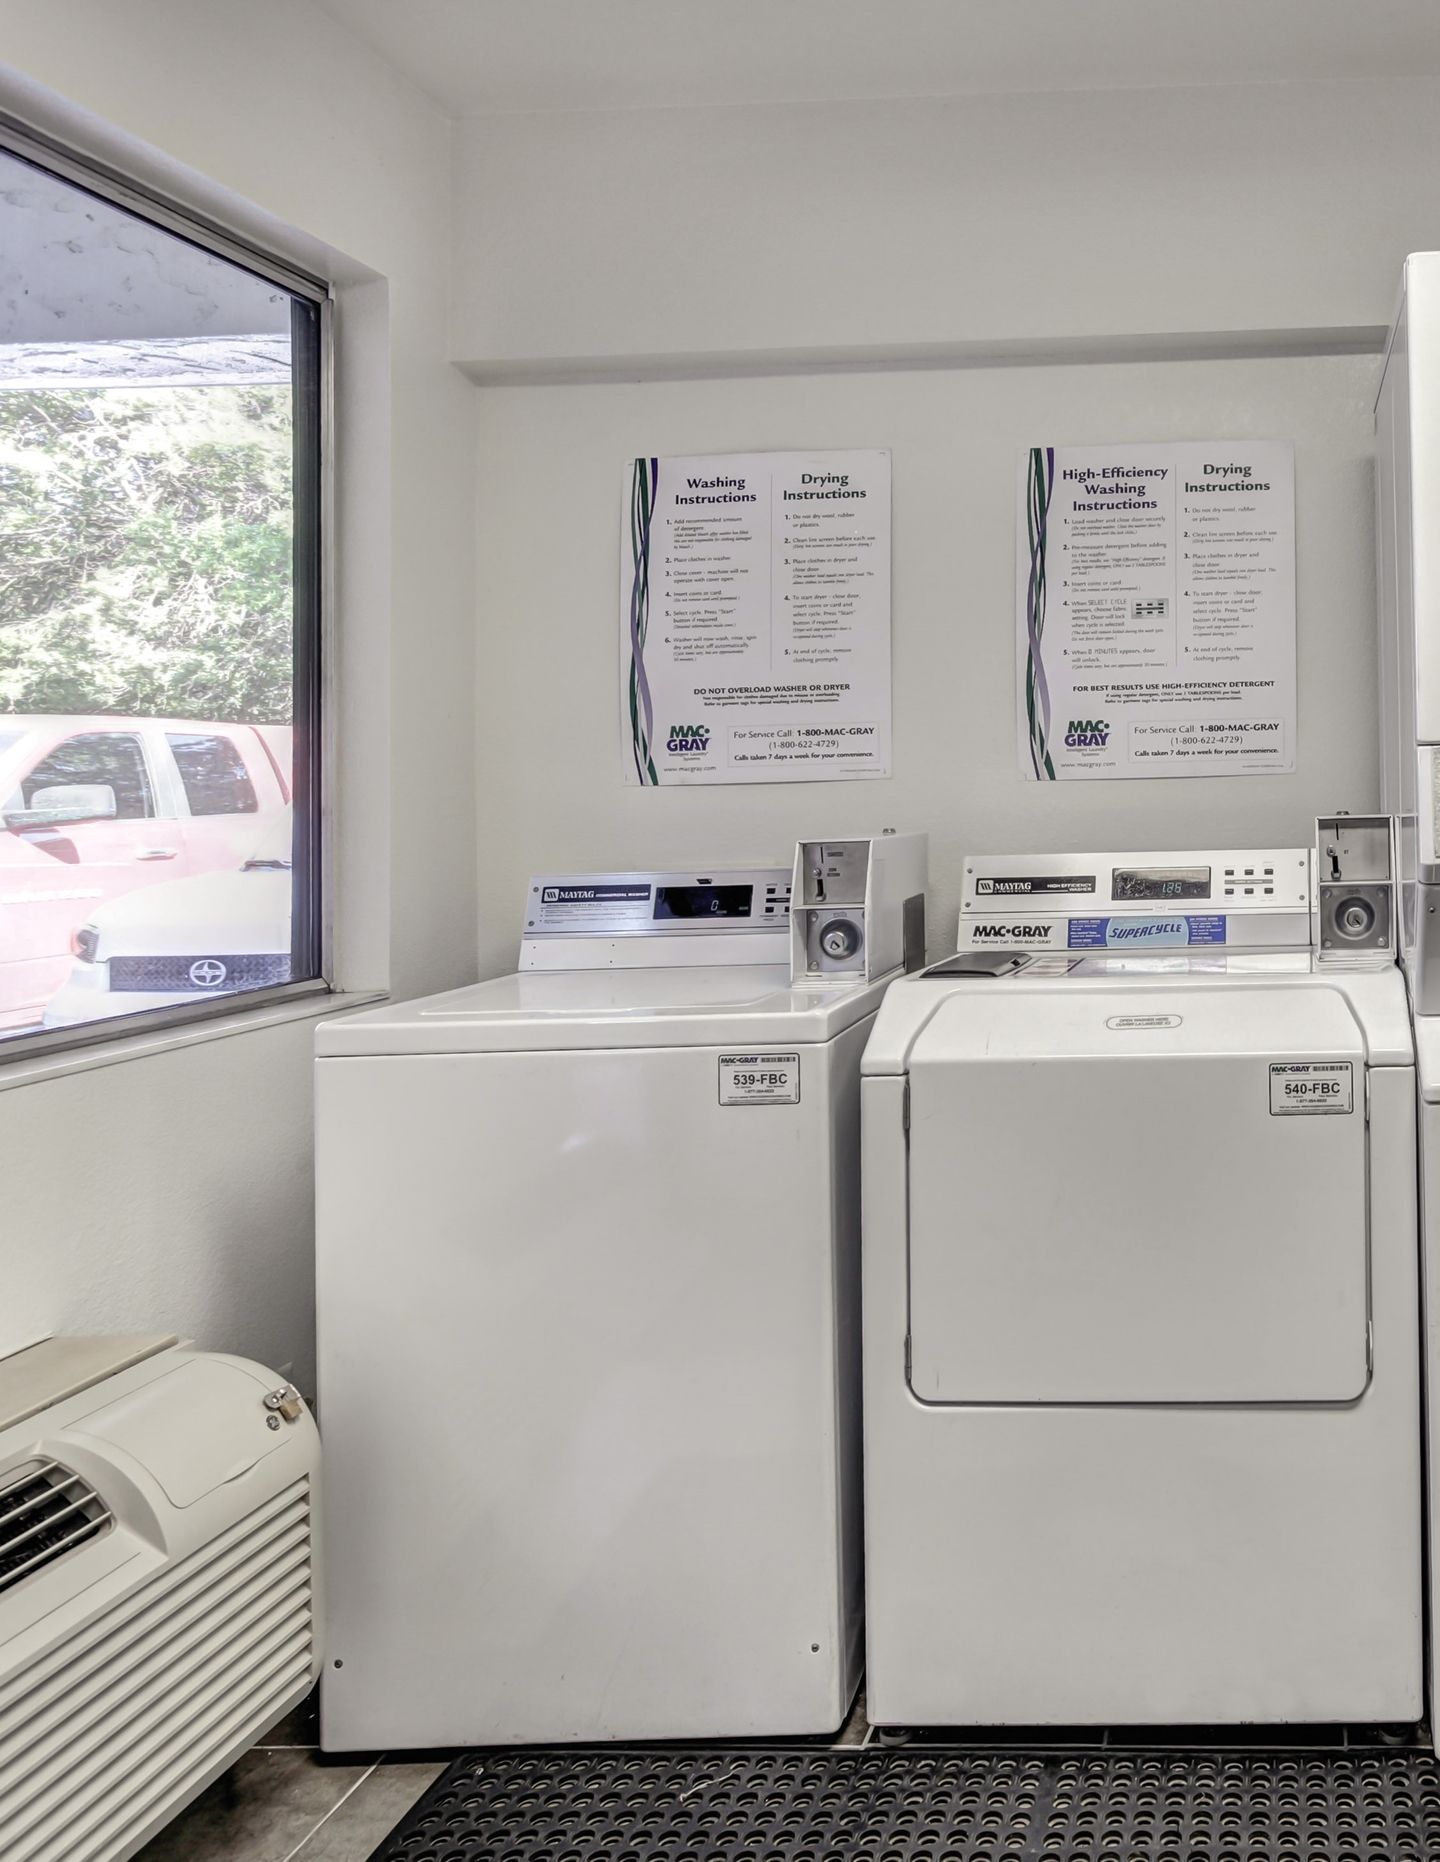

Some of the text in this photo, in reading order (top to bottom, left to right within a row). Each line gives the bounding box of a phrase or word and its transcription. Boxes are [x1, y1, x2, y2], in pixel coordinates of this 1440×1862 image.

[1062, 466, 1169, 483] High-Efficiency
[1203, 463, 1252, 478] Drying
[687, 476, 746, 490] Washing
[801, 473, 849, 487] Drying
[1185, 480, 1271, 493] Instructions
[783, 487, 867, 501] Instructions
[1084, 482, 1146, 497] Washing
[675, 491, 757, 505] Instructions
[1073, 499, 1158, 512] Instructions
[693, 683, 851, 695] DO NOT OVERLOAD WASHER OR DRYER
[1161, 682, 1227, 690] HIGH-EFFICIENCY
[1229, 680, 1276, 688] DETERGENT
[734, 731, 747, 739] For
[750, 730, 775, 739] Service
[797, 727, 875, 737] 1-800-MAC-GRAY
[1134, 727, 1148, 735] For
[1150, 725, 1176, 734] Service
[1199, 722, 1280, 733] 1-800-MAC-GRAY
[666, 737, 711, 752] GRAY
[768, 739, 840, 751] (1-800-622-4729)
[1064, 732, 1111, 747] GRAY
[1170, 735, 1244, 746] (1-800-622-4729)
[774, 753, 788, 762] days
[795, 752, 810, 760] week
[811, 752, 820, 760] for
[821, 753, 835, 761] your
[836, 751, 874, 760] convenience.
[1151, 749, 1168, 757] taken
[1175, 749, 1190, 758] days
[1197, 748, 1213, 756] week
[1224, 749, 1238, 757] your
[1240, 747, 1279, 755] convenience.
[663, 765, 717, 773] www.macgray.com
[1060, 761, 1116, 770] www.macgray.com
[994, 882, 1032, 891] MAYTAG
[559, 890, 595, 899] MAYTAG
[1108, 923, 1182, 939] SUPERCYCLE
[733, 1073, 788, 1086] 539-FBC
[1284, 1082, 1341, 1095] 540-FBC
